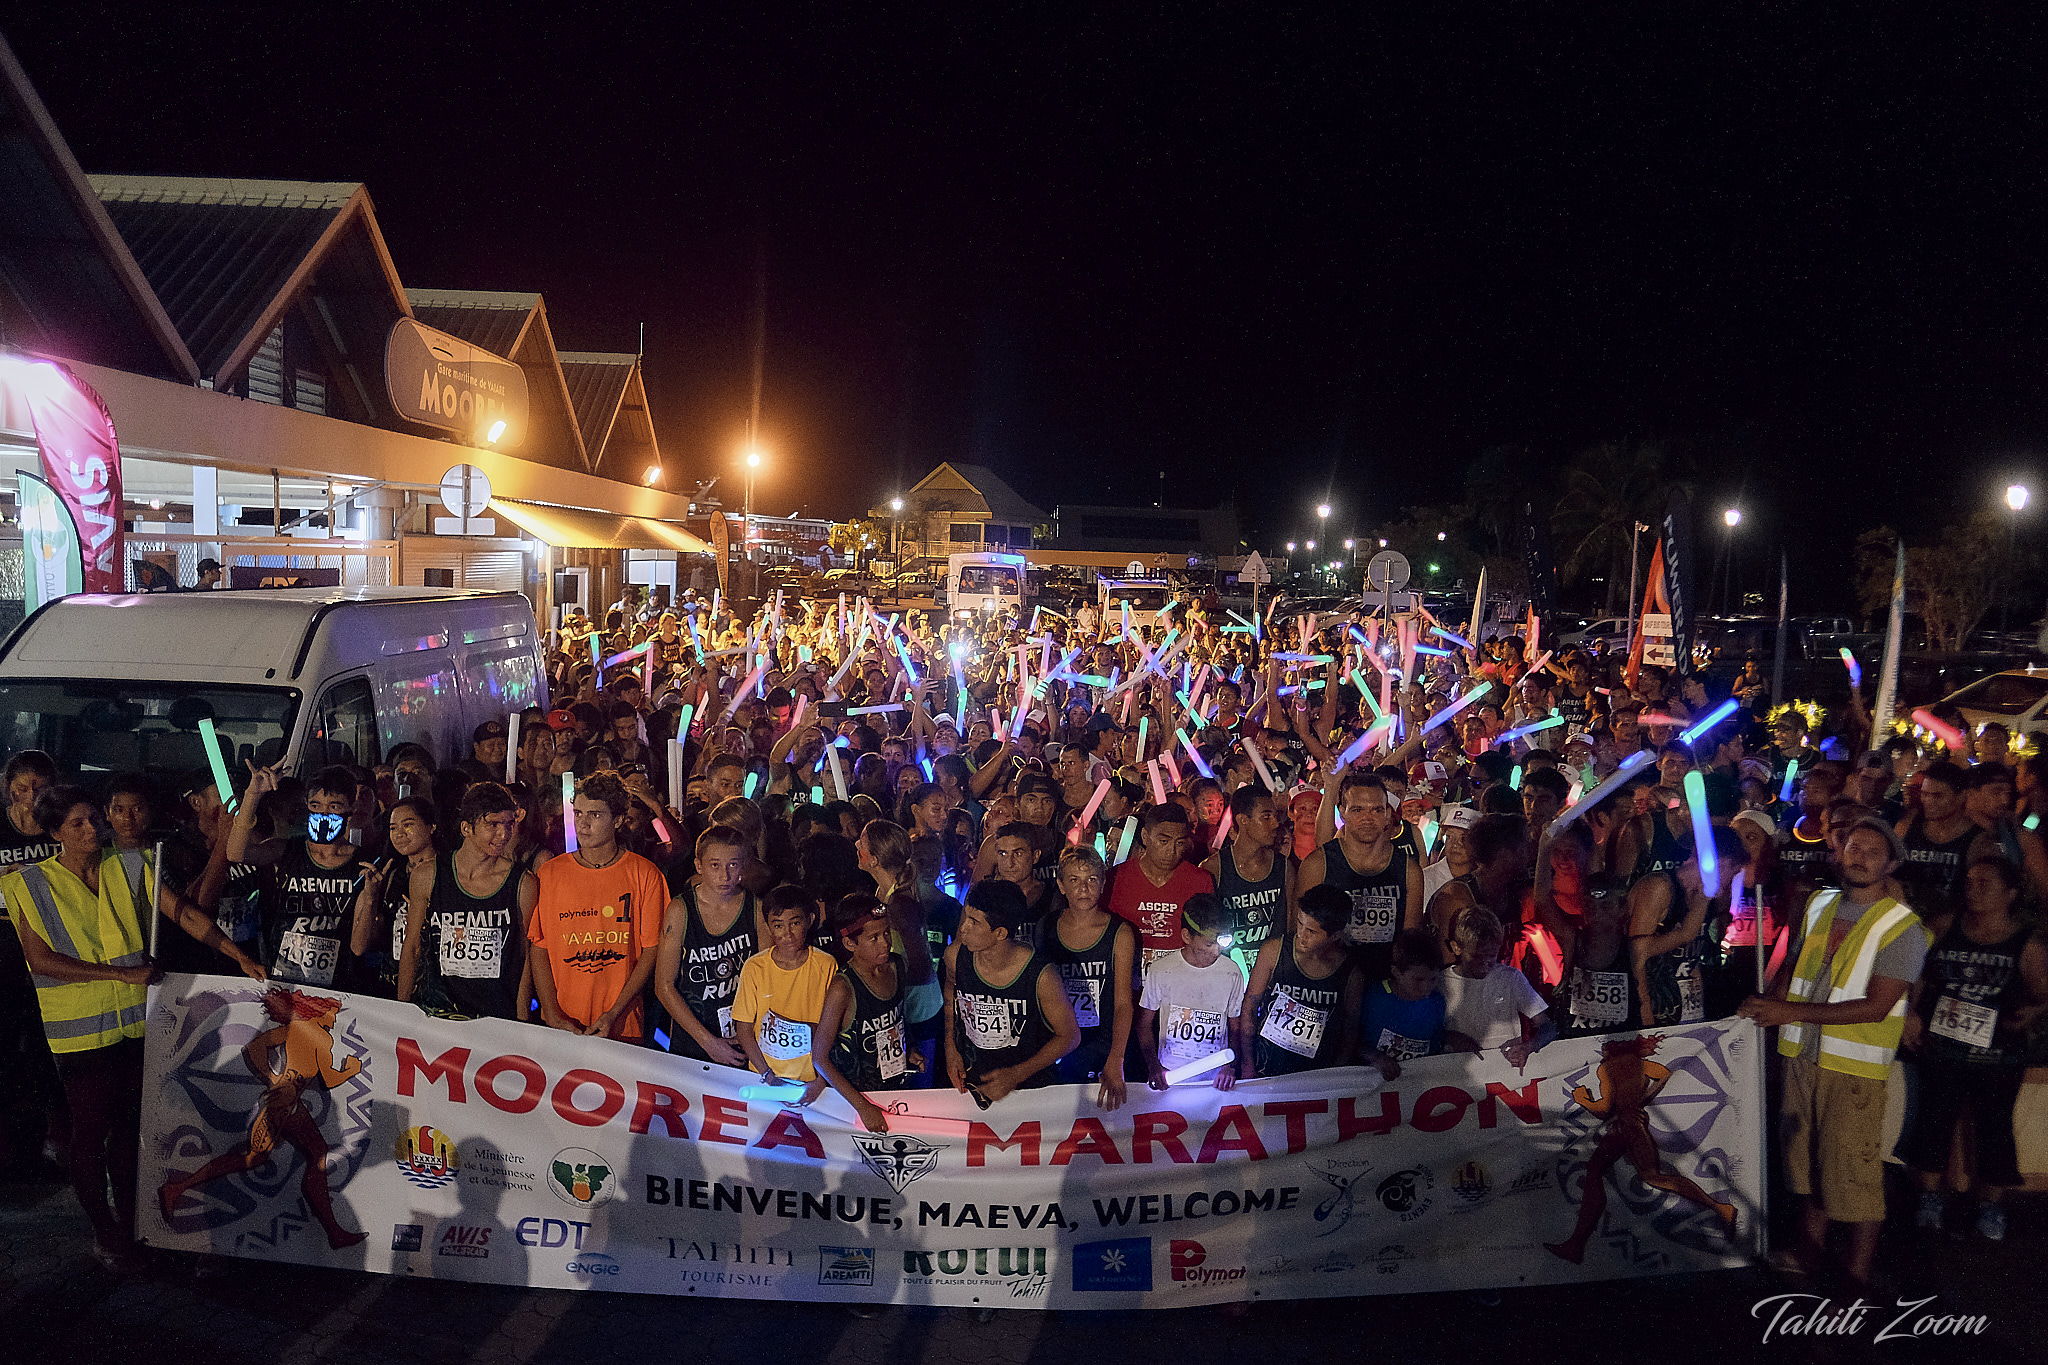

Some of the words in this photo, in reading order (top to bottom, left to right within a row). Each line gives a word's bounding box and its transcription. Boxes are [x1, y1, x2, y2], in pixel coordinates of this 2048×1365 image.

[437, 362, 452, 378] Gare
[453, 369, 478, 387] maritime
[479, 378, 487, 390] de
[69, 456, 116, 574] AVIS
[287, 877, 353, 894] AREMITI
[430, 908, 511, 929] AREMITI
[559, 908, 599, 921] polynésie
[616, 892, 631, 923] 1
[1137, 901, 1178, 913] ASCEP
[291, 916, 341, 933] RUN
[444, 941, 494, 961] 1855
[688, 933, 751, 964] AREMITI
[1271, 982, 1338, 1005] AREMITI
[762, 1022, 803, 1048] 1688
[1168, 1020, 1216, 1044] 1094
[1273, 1008, 1316, 1040] 1781
[395, 1036, 827, 1160] MOOREA
[966, 1076, 1547, 1167] MARATHON
[474, 1148, 525, 1165] Ministère
[464, 1161, 477, 1170] de
[479, 1163, 489, 1173] la
[490, 1165, 536, 1181] jeunesse
[468, 1176, 479, 1185] et
[482, 1176, 500, 1188] des
[502, 1179, 534, 1192] sports
[646, 1173, 903, 1231] BIENVENUE,
[918, 1200, 1080, 1233] MAEVA,
[1092, 1186, 1300, 1227] WELCOME
[1400, 1197, 1433, 1223] EVENTS
[441, 1225, 493, 1246] AVIS
[515, 1216, 591, 1250] EDT
[1170, 1240, 1247, 1284] Polymat
[680, 1270, 774, 1287] TOURISME
[903, 1277, 923, 1285] TOUT
[935, 1278, 965, 1286] PLAISIR
[1006, 1270, 1054, 1300] Tahiti
